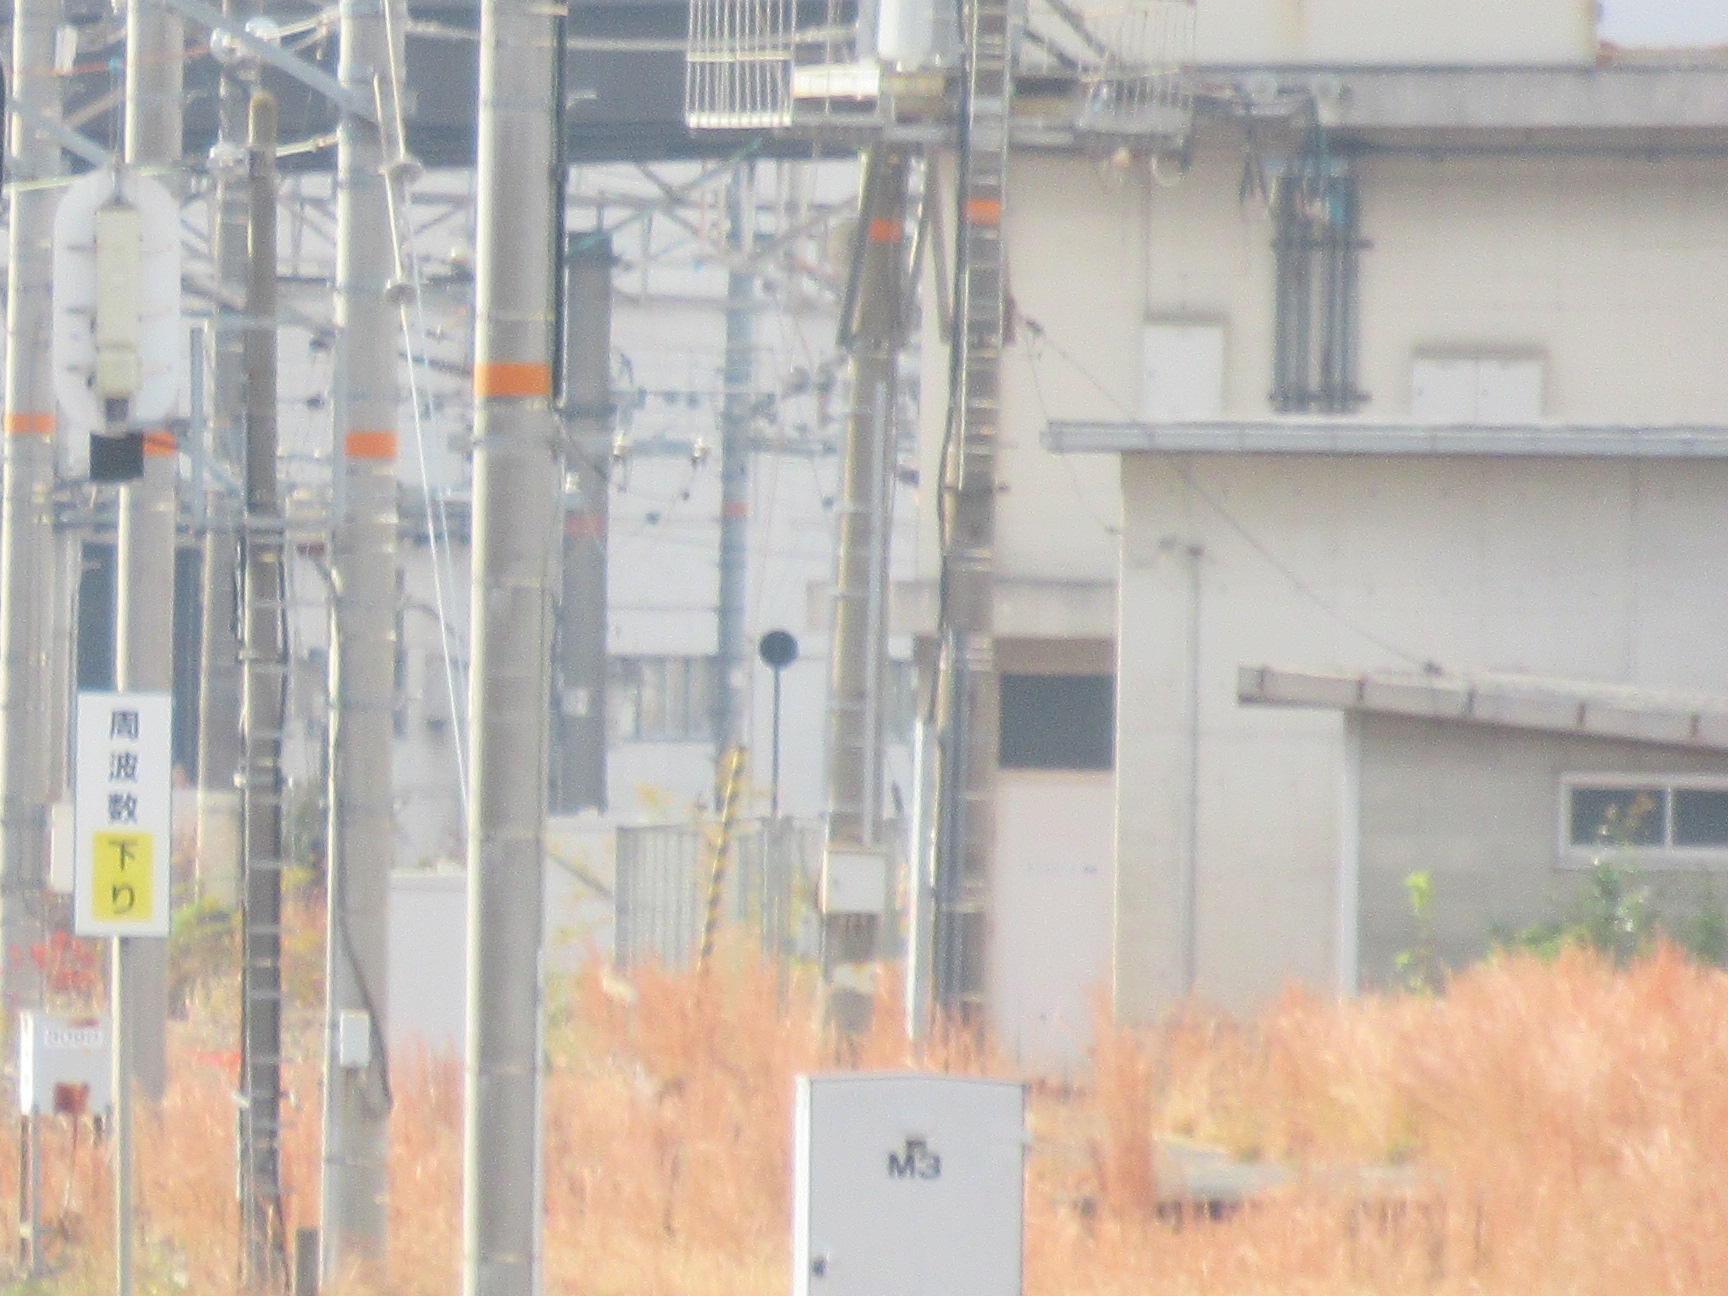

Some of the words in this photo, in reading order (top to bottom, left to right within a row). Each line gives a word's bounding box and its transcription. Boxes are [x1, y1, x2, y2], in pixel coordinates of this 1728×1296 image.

[107, 709, 139, 825] 周波数
[108, 839, 139, 916] 下り
